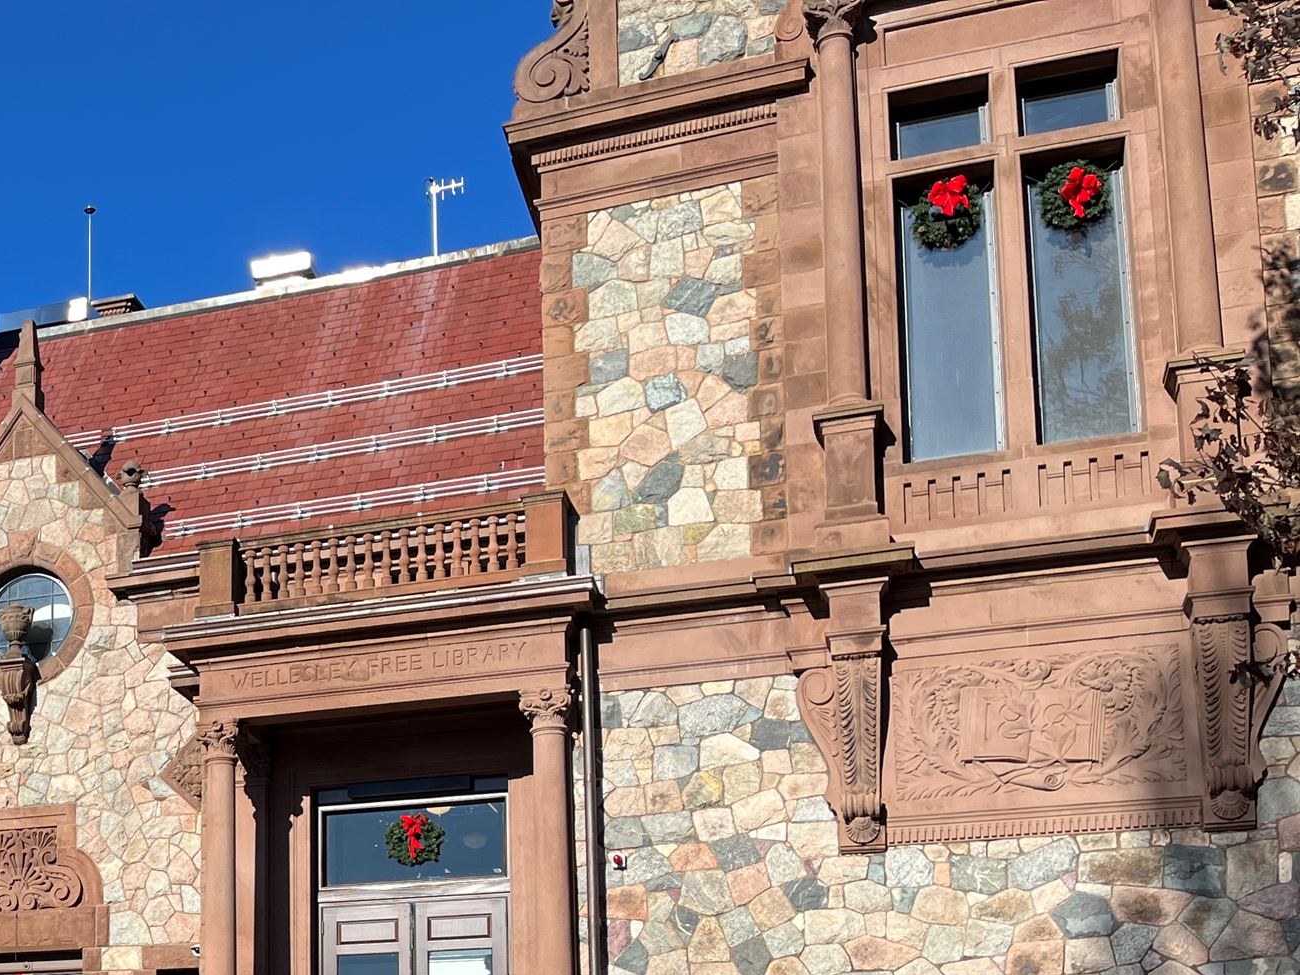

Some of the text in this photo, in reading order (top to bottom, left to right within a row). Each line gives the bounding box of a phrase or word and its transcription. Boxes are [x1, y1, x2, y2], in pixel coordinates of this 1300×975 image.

[231, 641, 528, 690] WELLESLEY FREE LIBRARY
